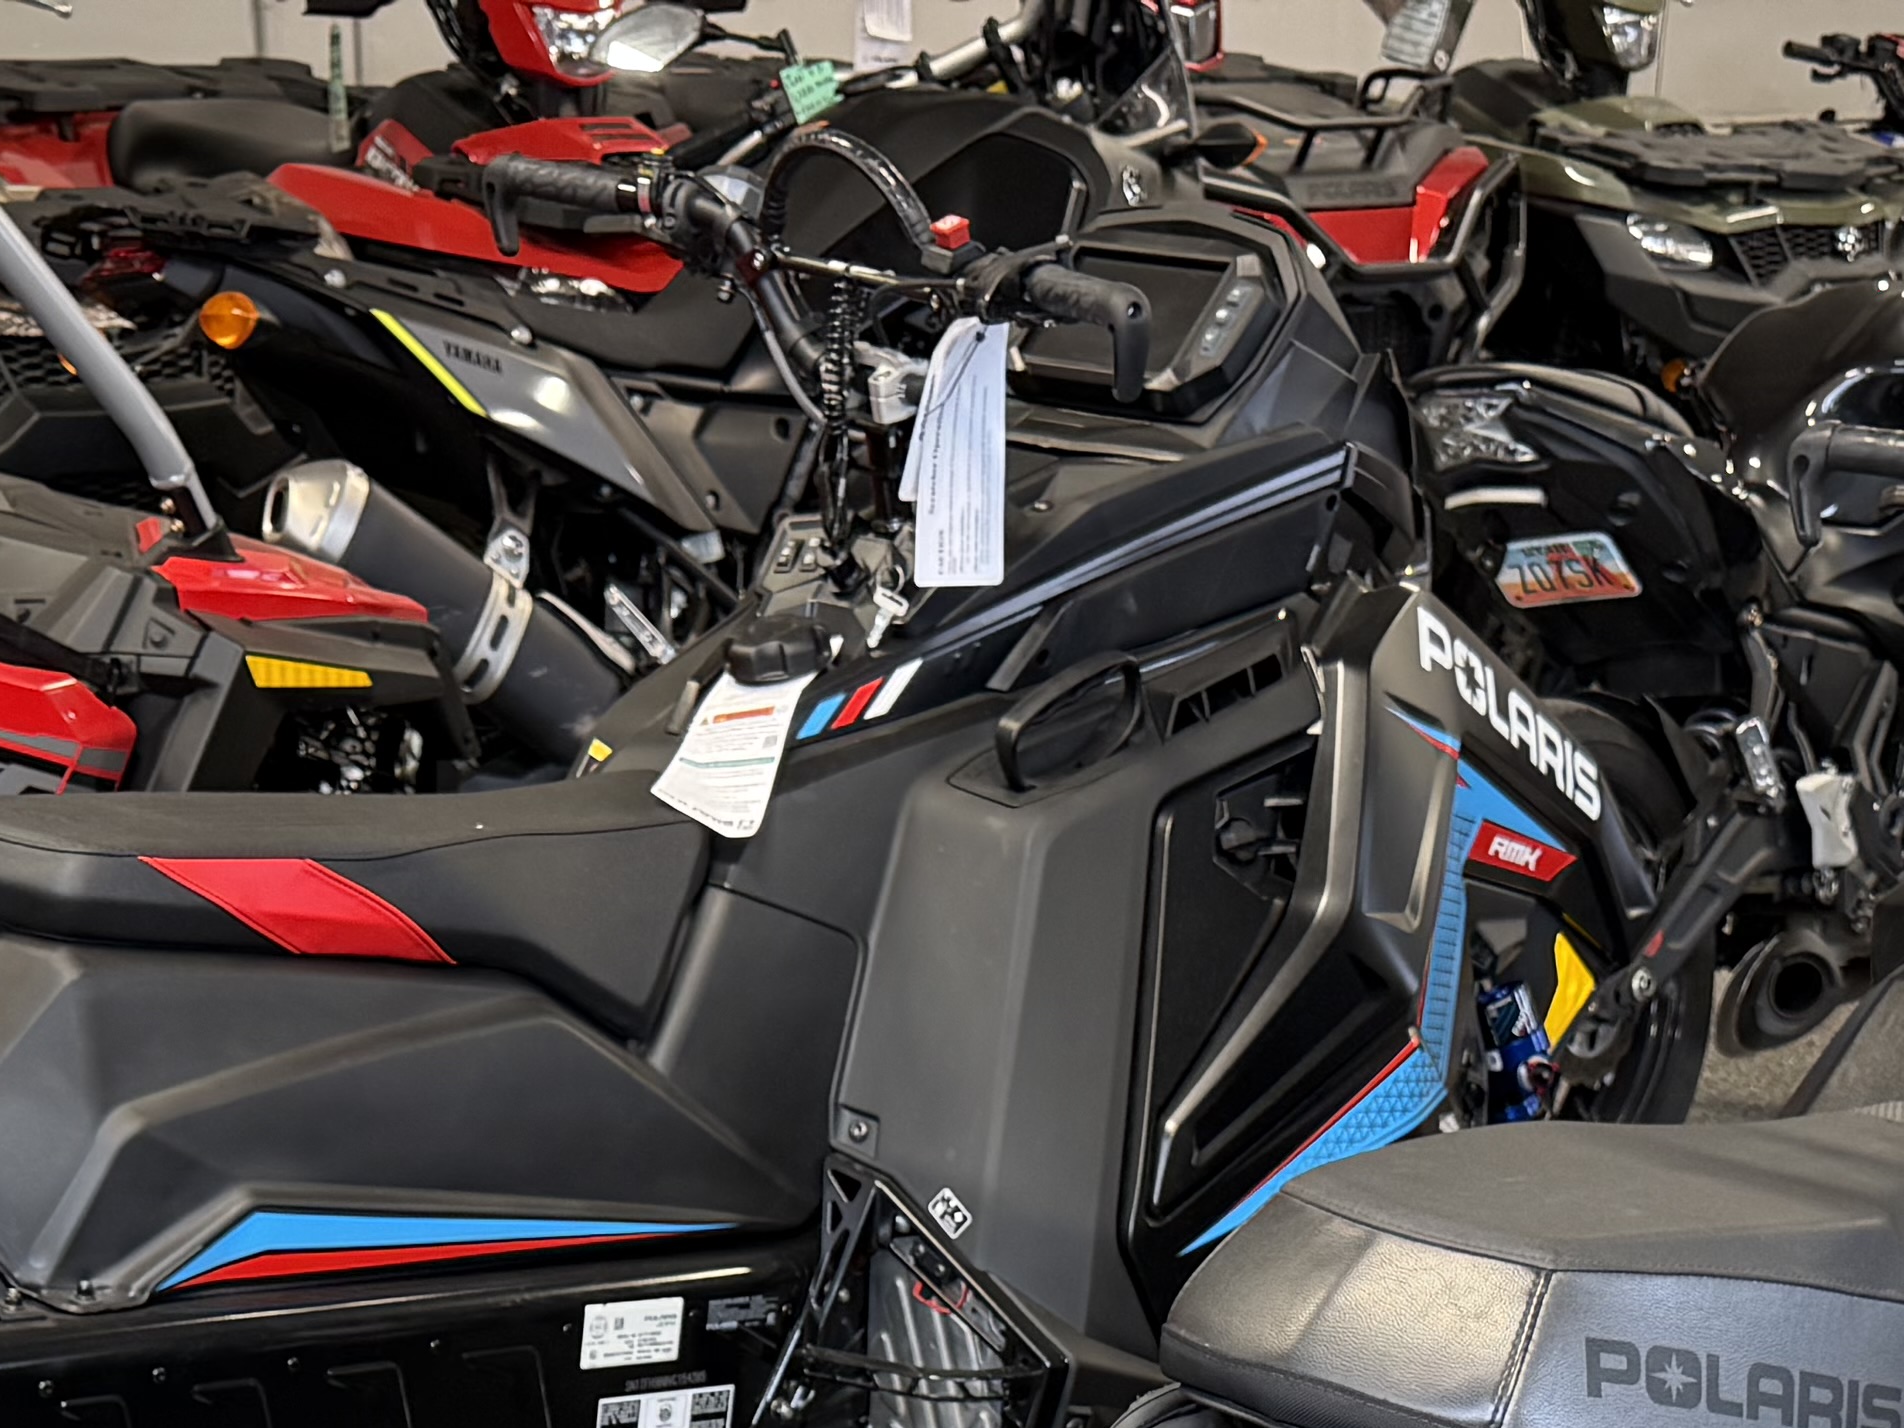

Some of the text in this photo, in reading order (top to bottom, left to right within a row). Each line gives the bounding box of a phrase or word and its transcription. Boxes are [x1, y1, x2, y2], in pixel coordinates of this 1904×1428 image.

[443, 339, 502, 375] YAMAHA
[1416, 606, 1602, 821] POLARIS
[1487, 834, 1543, 872] RMK
